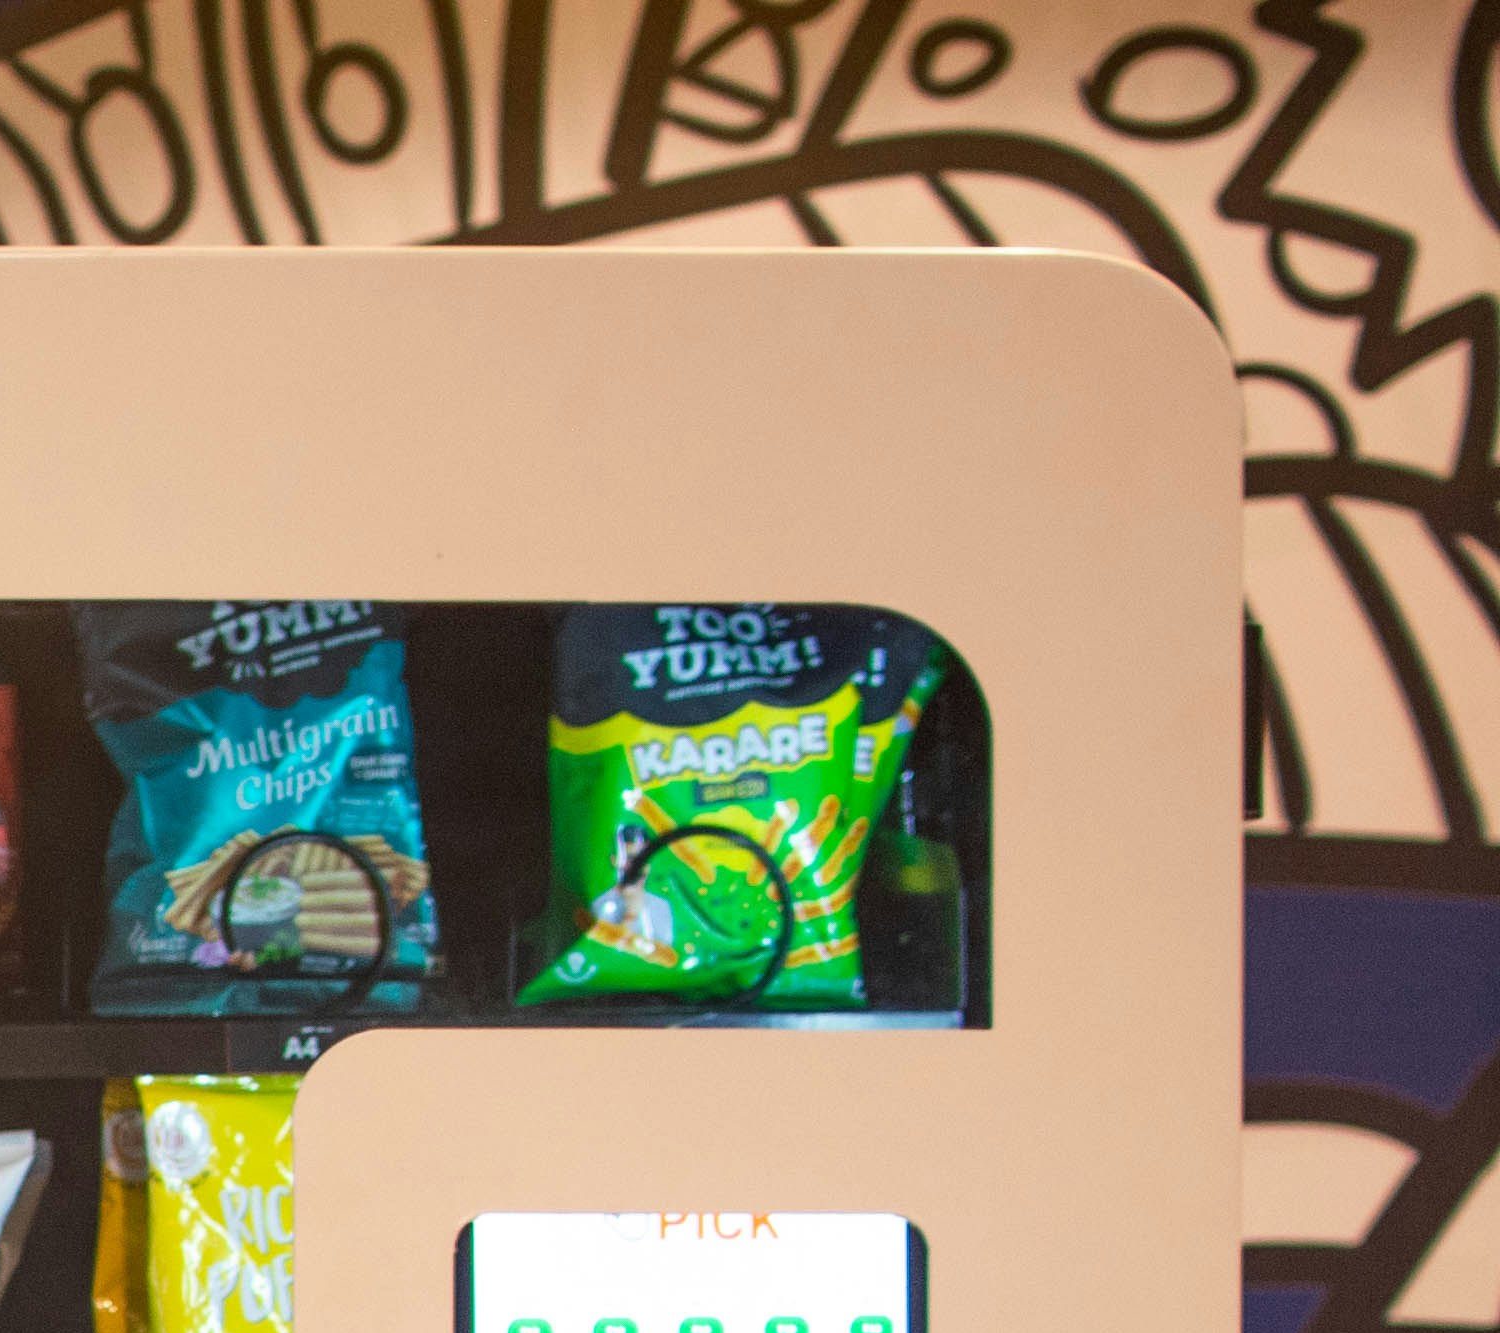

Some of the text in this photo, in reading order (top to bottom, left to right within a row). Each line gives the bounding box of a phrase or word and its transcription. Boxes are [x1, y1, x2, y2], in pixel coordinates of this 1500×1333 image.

[656, 606, 769, 643] TOO
[623, 636, 824, 690] YUMM!
[187, 697, 399, 779] Multigrain
[631, 713, 829, 784] KARARE
[235, 761, 333, 811] Chips
[282, 1036, 320, 1060] A4
[220, 1182, 293, 1252] RIC
